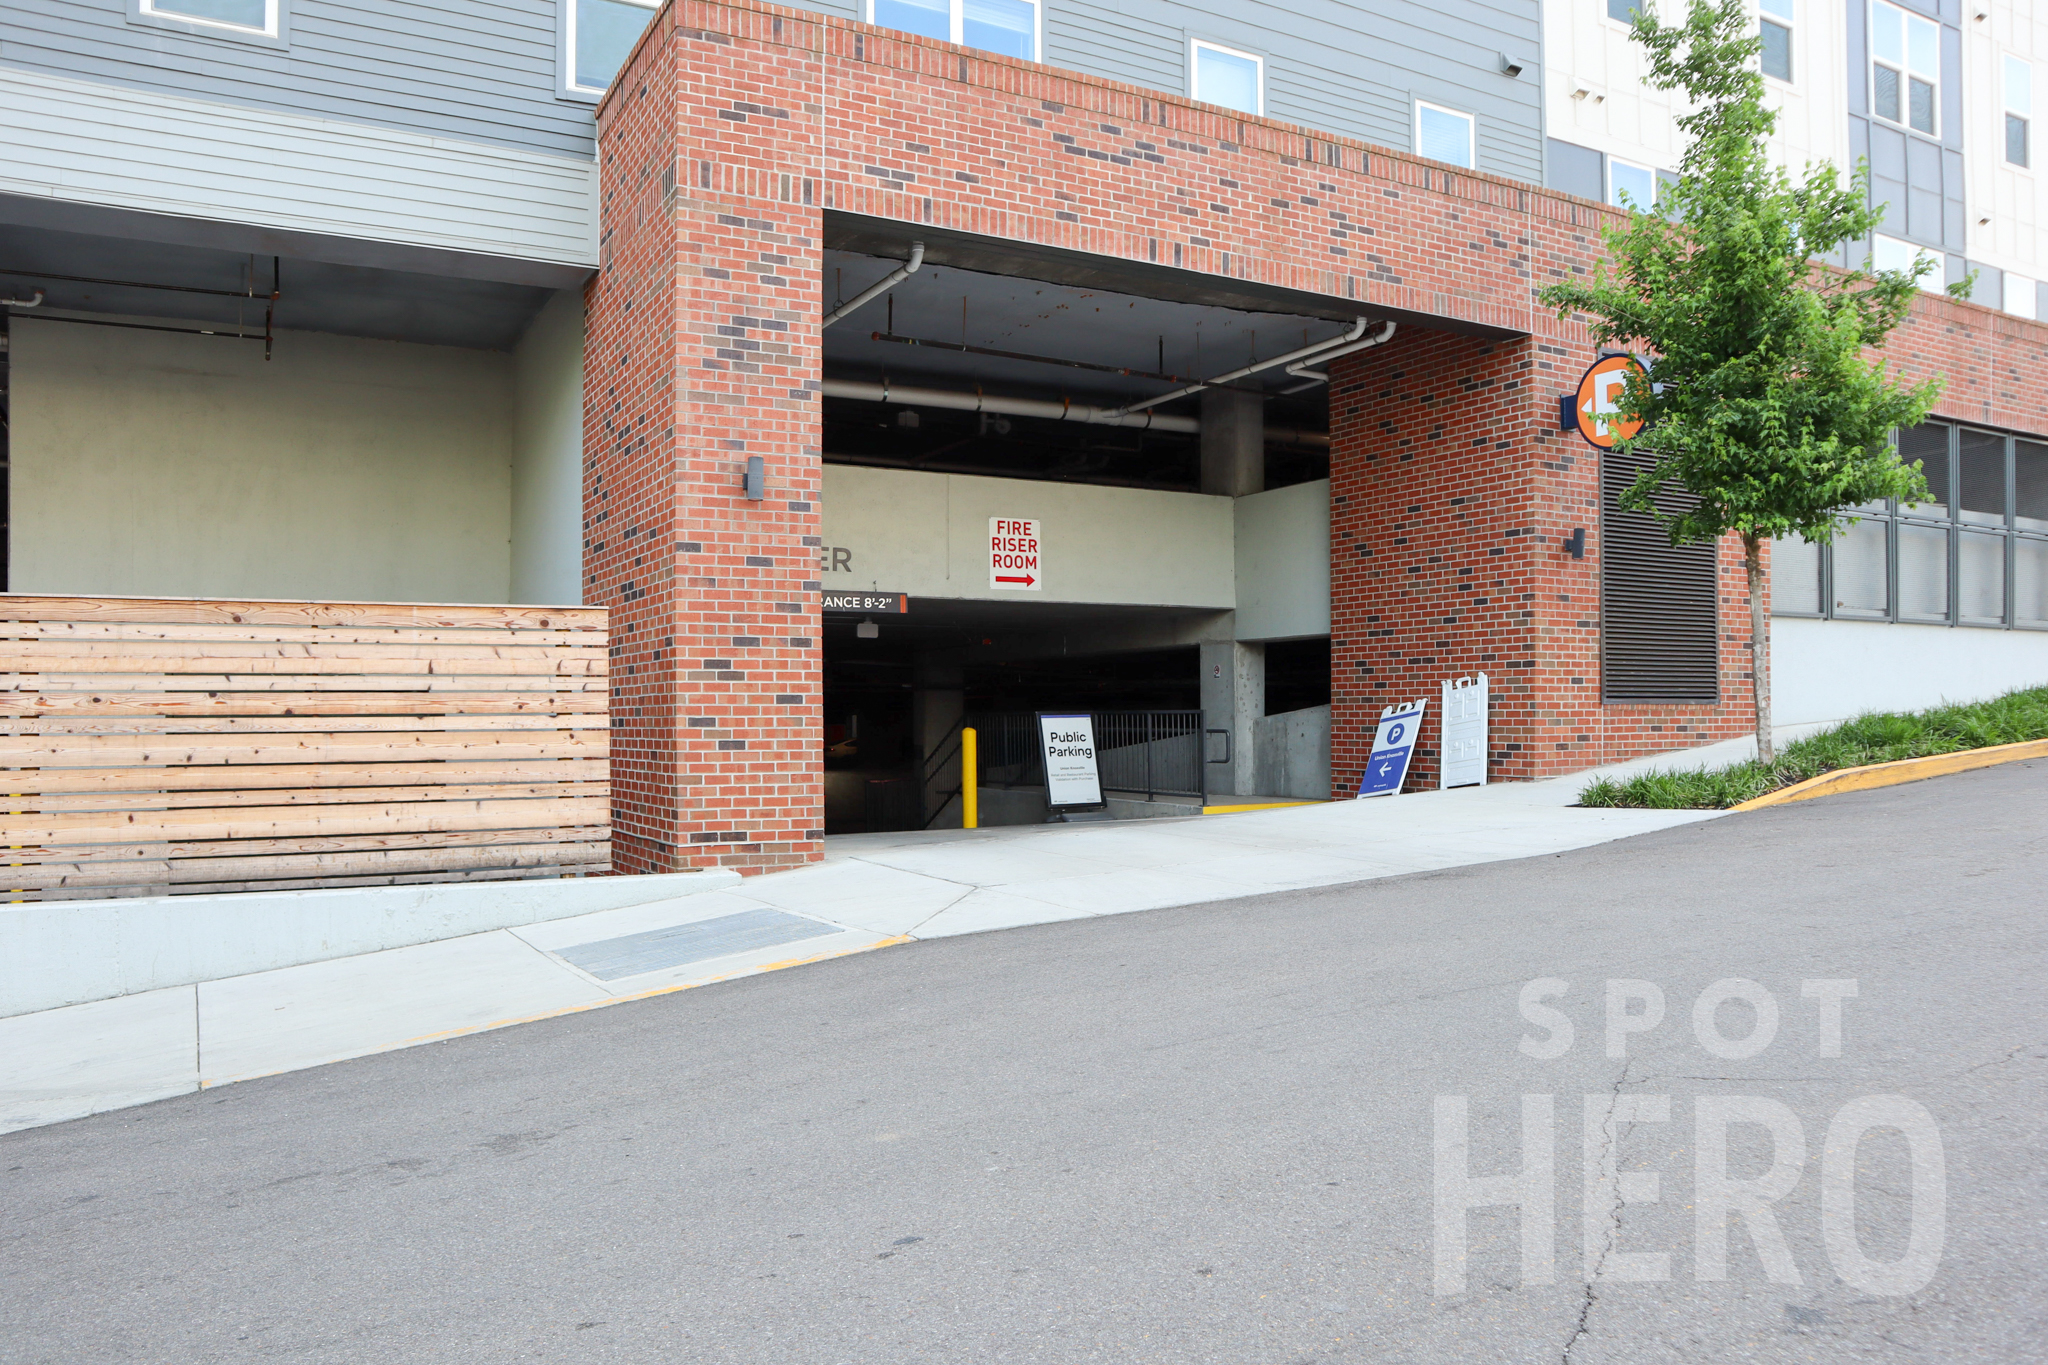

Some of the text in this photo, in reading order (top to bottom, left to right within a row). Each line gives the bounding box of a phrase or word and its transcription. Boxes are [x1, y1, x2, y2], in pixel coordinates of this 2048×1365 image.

[997, 520, 1032, 536] FIRE
[991, 537, 1038, 553] RISER
[992, 554, 1037, 570] ROOM
[821, 596, 861, 608] ANCE
[1050, 732, 1086, 742] Public
[1390, 728, 1401, 741] P
[1049, 746, 1092, 758] Parking
